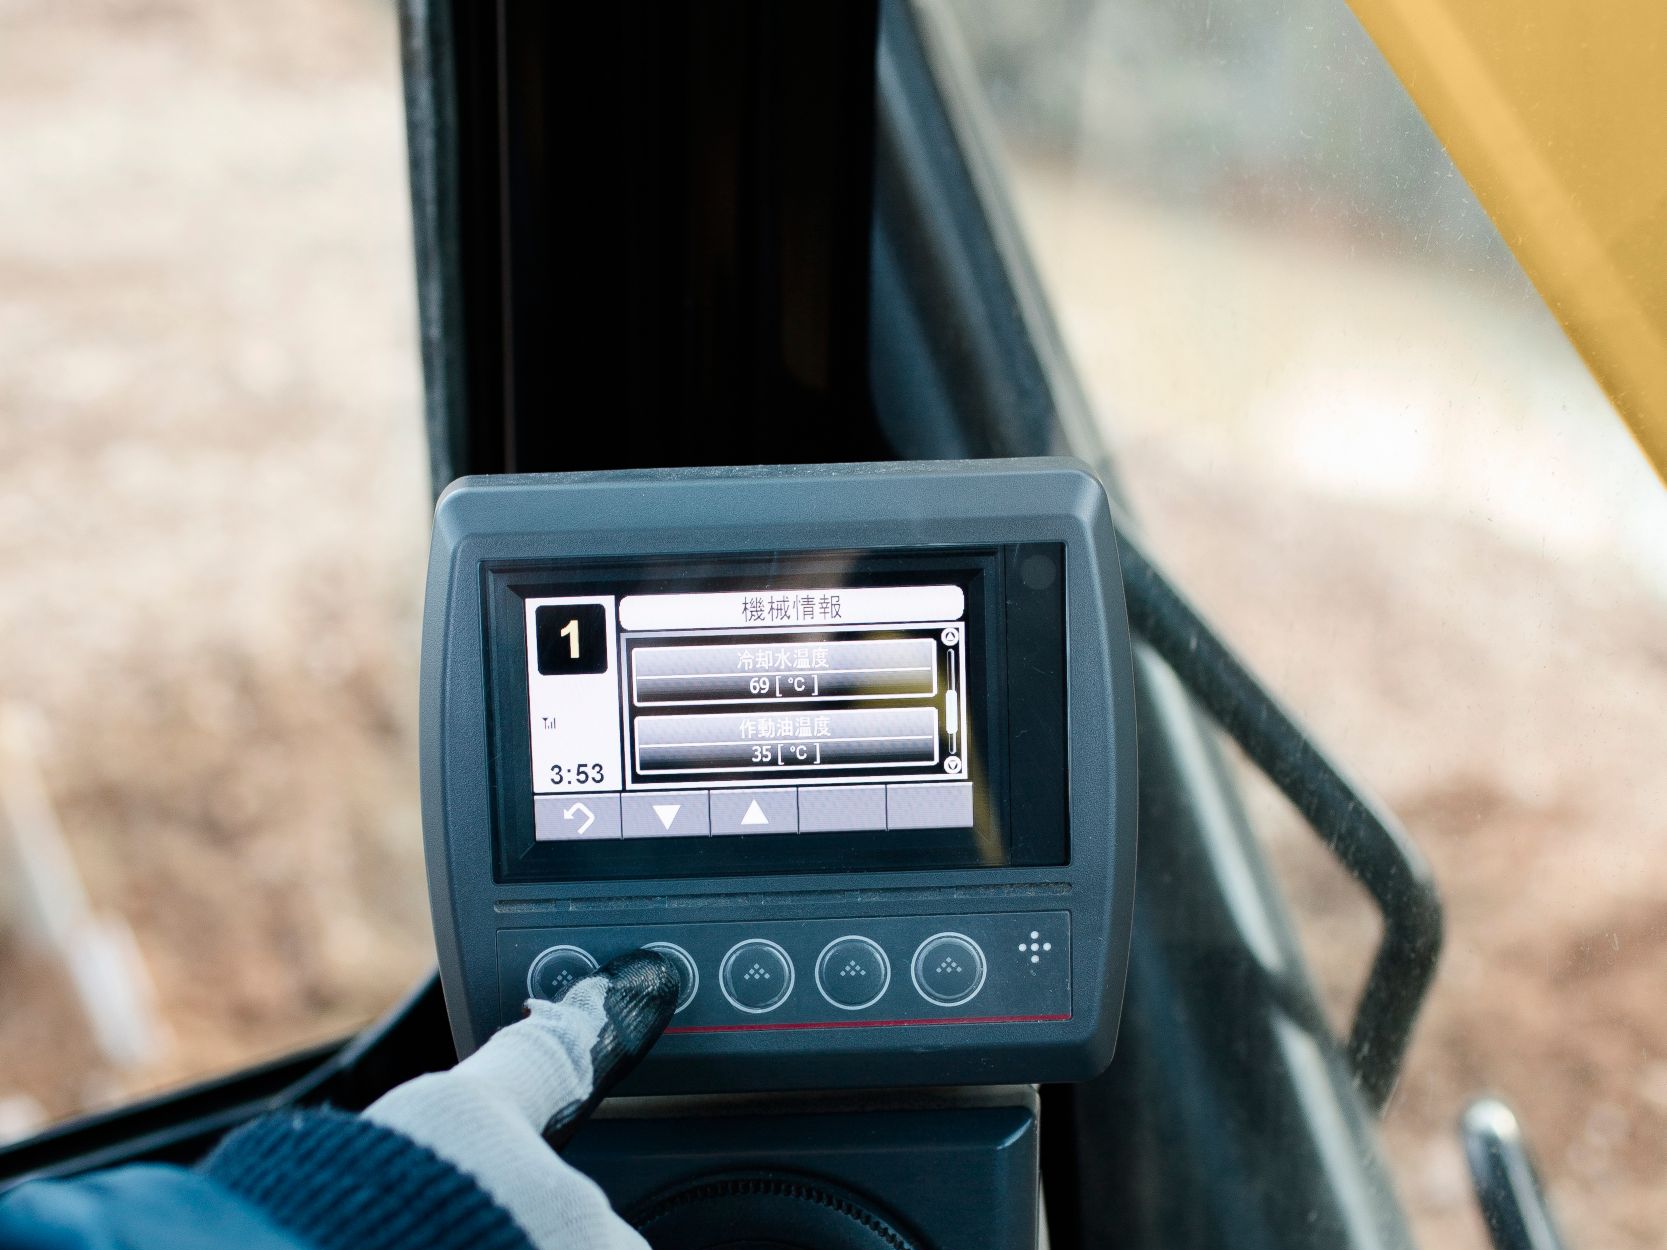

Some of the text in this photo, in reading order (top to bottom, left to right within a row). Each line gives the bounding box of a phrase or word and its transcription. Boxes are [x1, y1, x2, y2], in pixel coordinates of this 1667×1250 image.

[742, 594, 842, 622] 機械情報
[560, 619, 580, 659] 1
[737, 647, 830, 671] 冷却水温度
[739, 716, 832, 739] 作動油温度
[550, 763, 605, 785] 3:53
